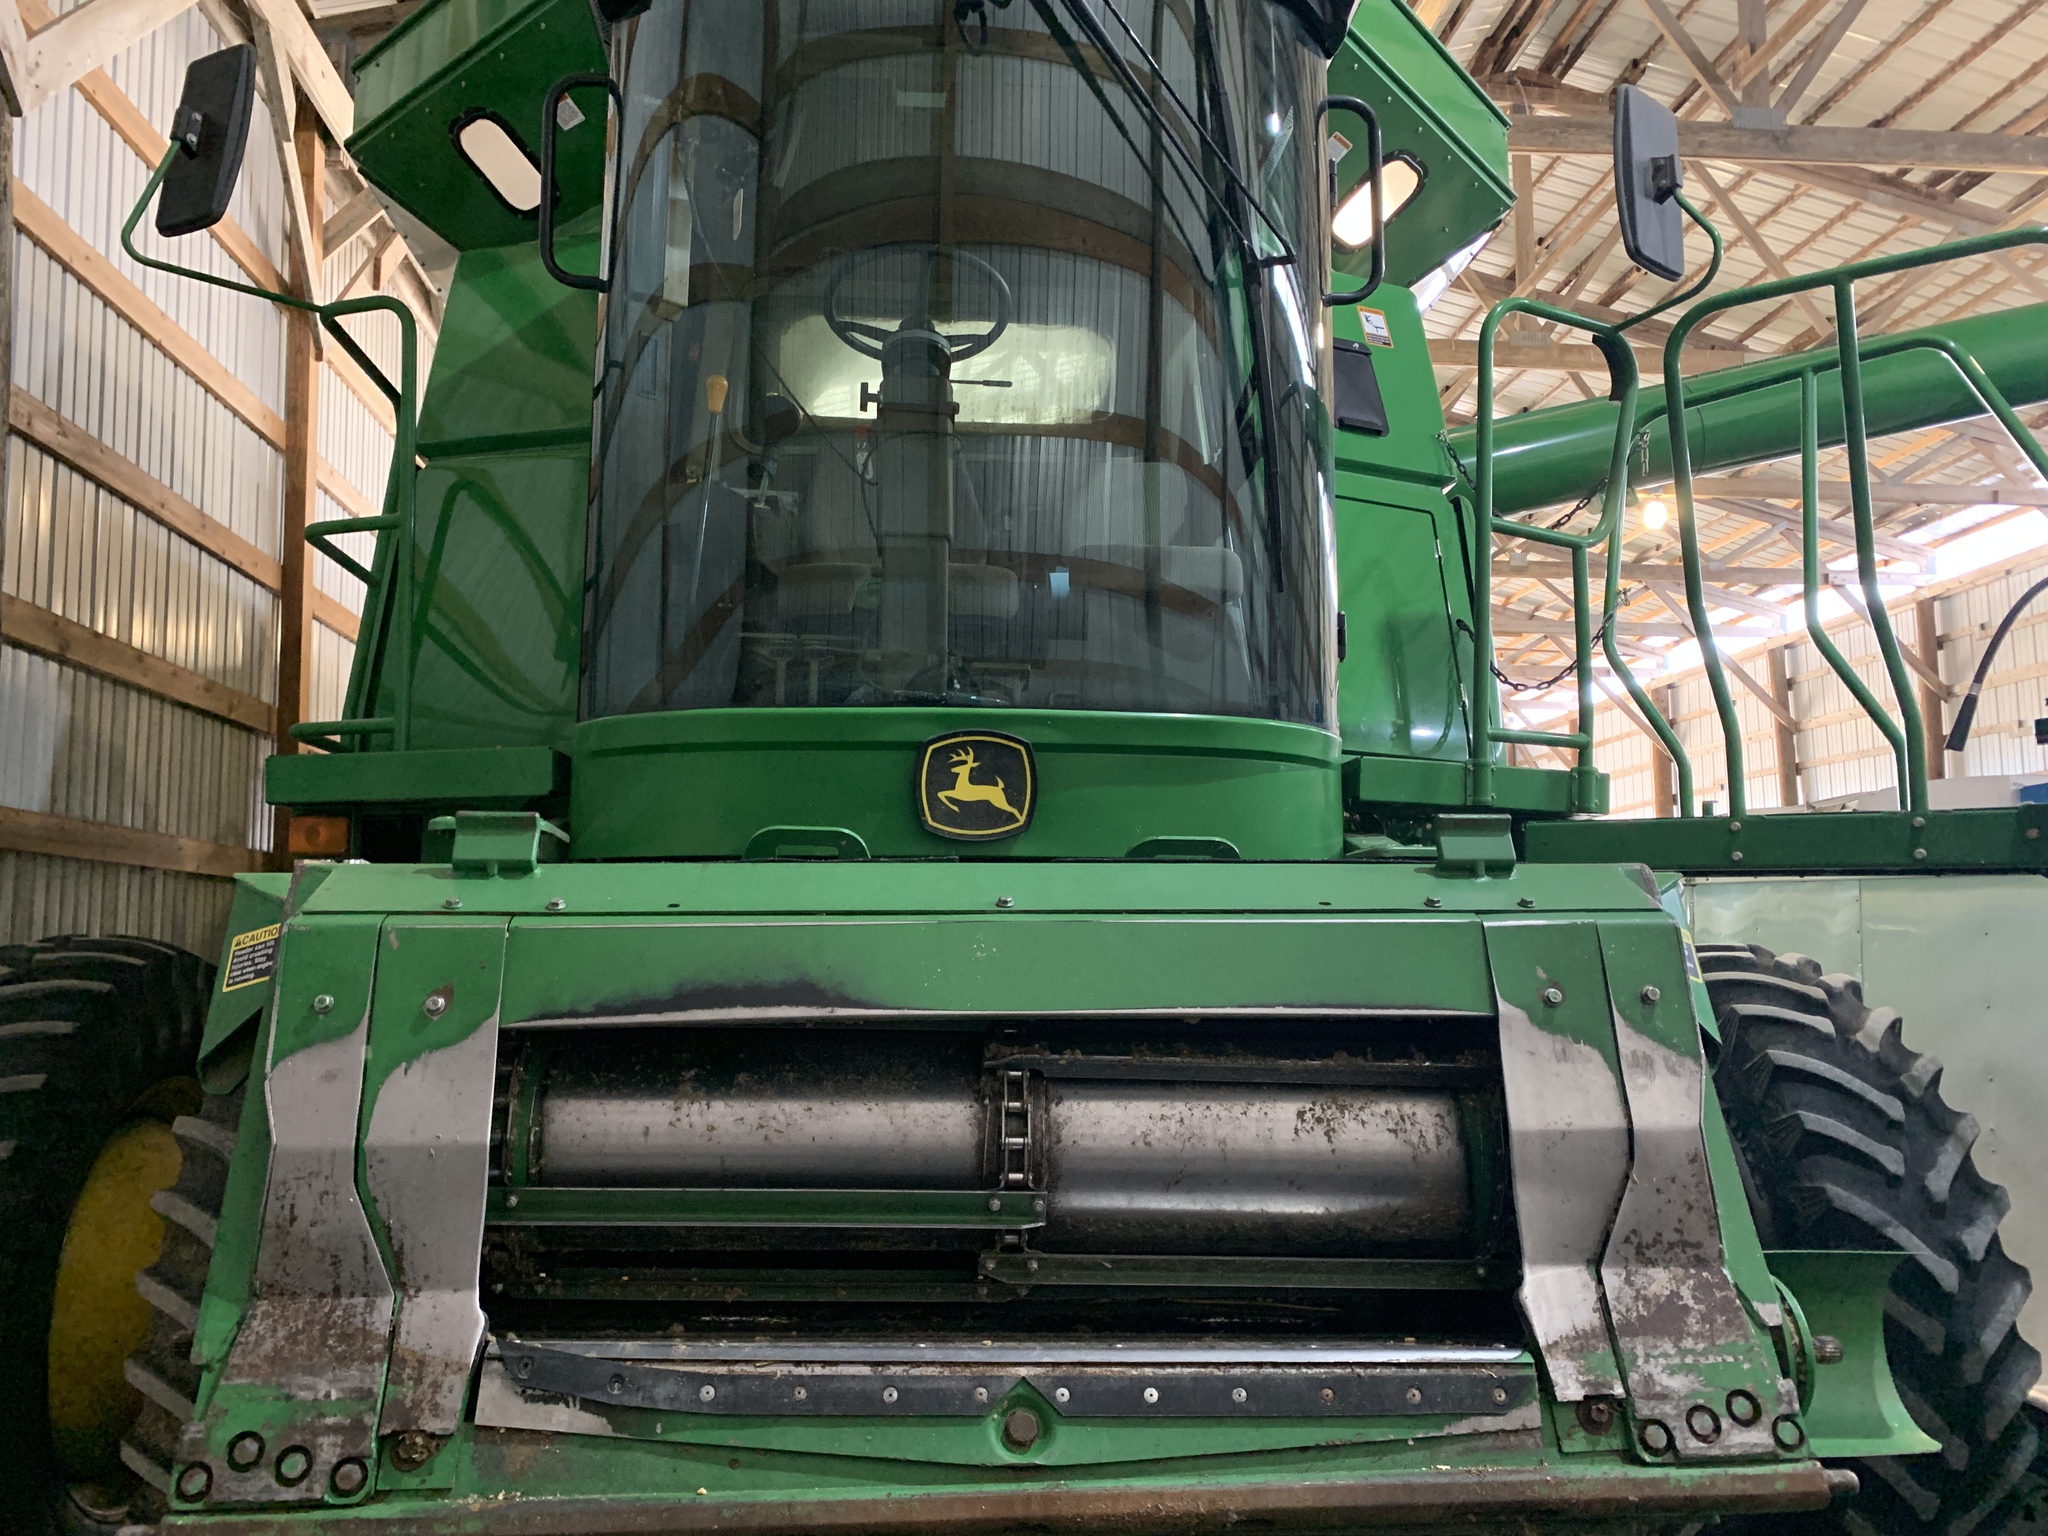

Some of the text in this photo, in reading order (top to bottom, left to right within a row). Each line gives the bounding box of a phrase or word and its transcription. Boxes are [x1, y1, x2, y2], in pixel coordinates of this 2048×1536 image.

[242, 927, 278, 945] CAUTIO
[232, 947, 274, 964] Avoid crushing
[254, 943, 266, 951] can
